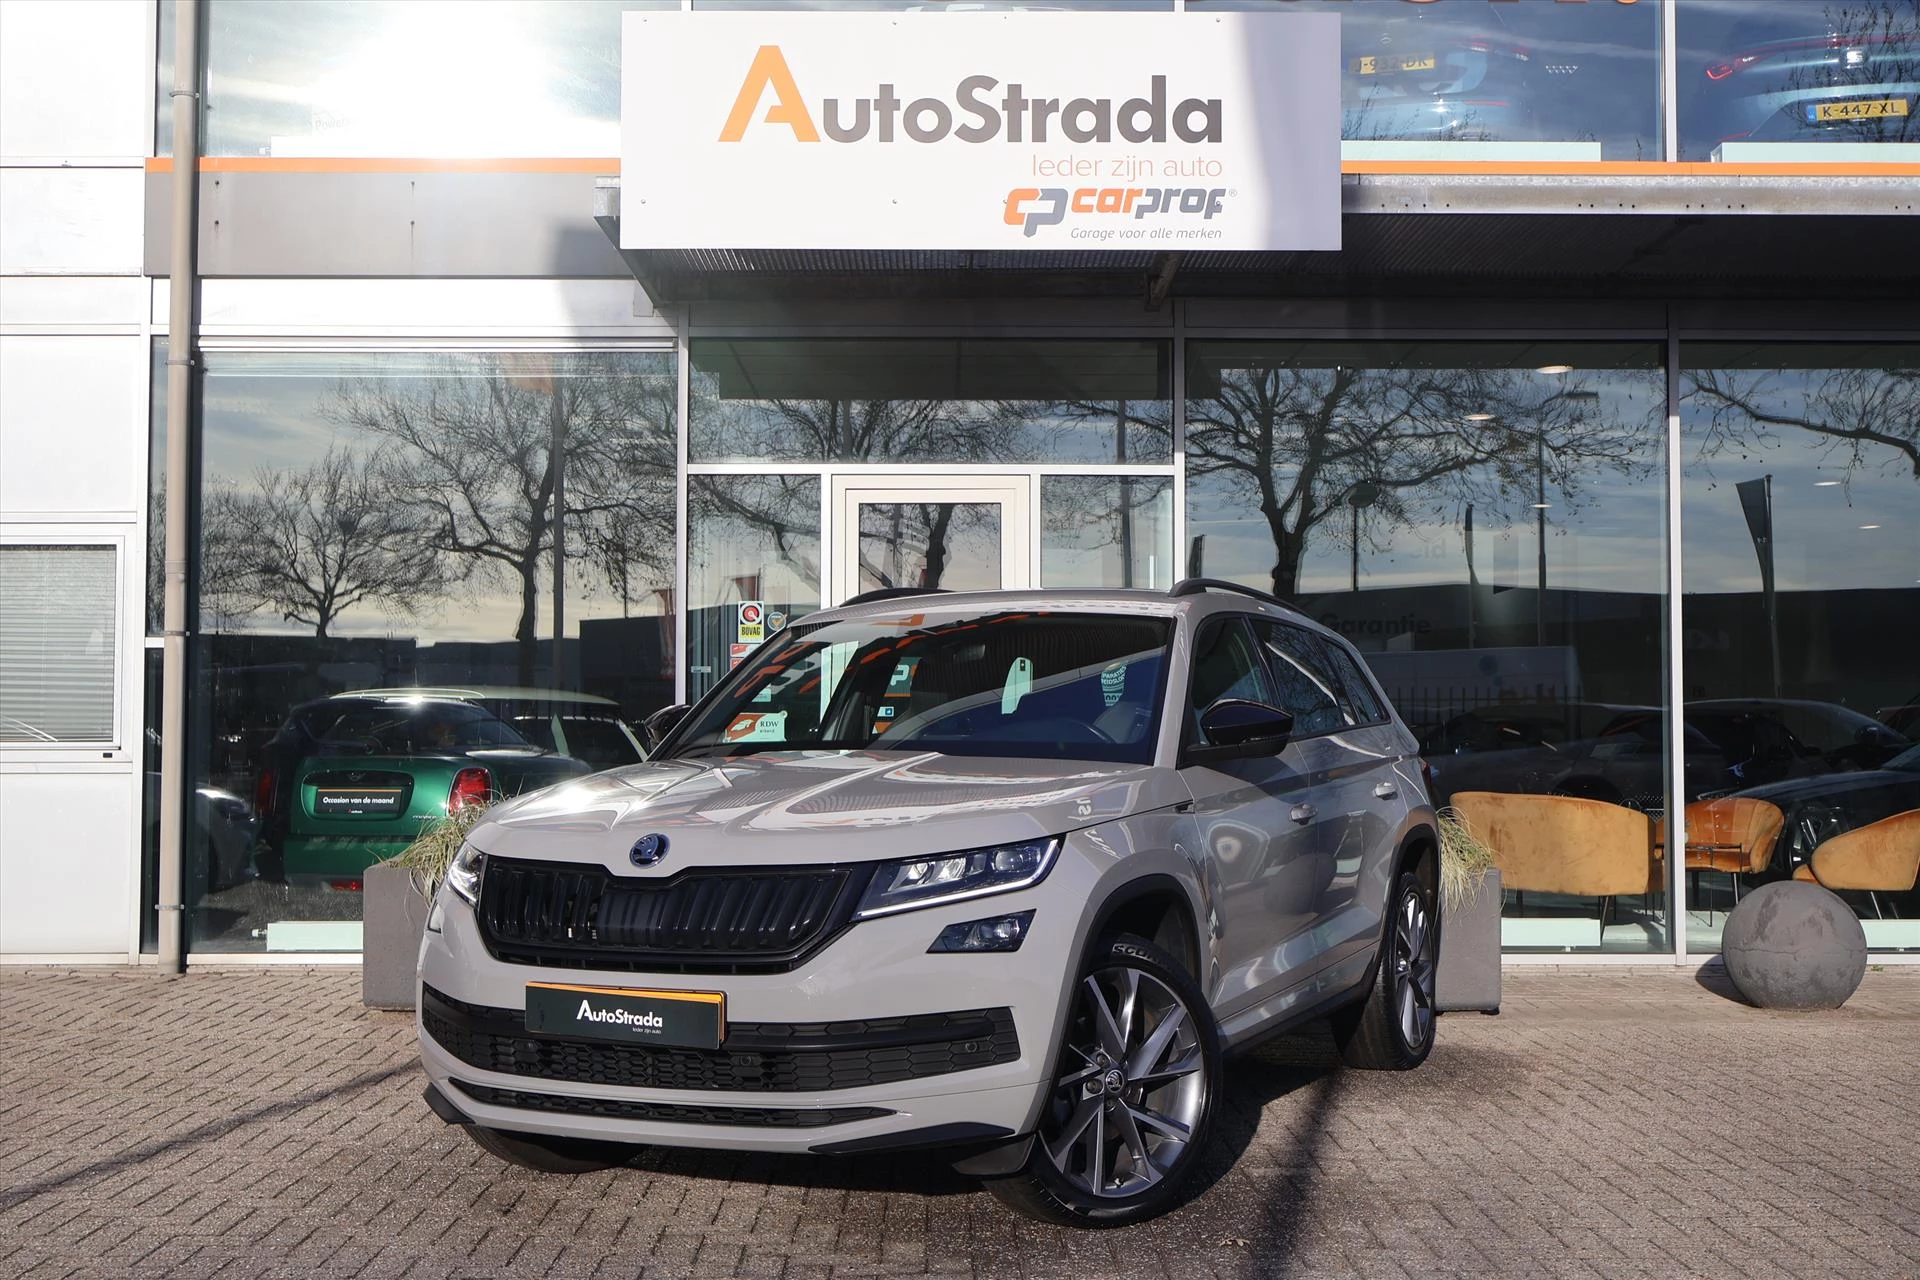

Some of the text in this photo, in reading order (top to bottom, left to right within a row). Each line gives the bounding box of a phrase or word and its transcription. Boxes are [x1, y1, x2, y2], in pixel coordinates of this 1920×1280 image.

[717, 45, 1223, 144] AutoStrada
[1823, 102, 1900, 117] K-447-XL
[1032, 154, 1223, 182] Ieder zijn auto
[1070, 227, 1222, 241] Garage voor alle merken
[741, 626, 761, 636] BOVAG
[322, 796, 350, 804] Occasion
[362, 796, 371, 804] de
[576, 999, 663, 1028] AutoStrada
